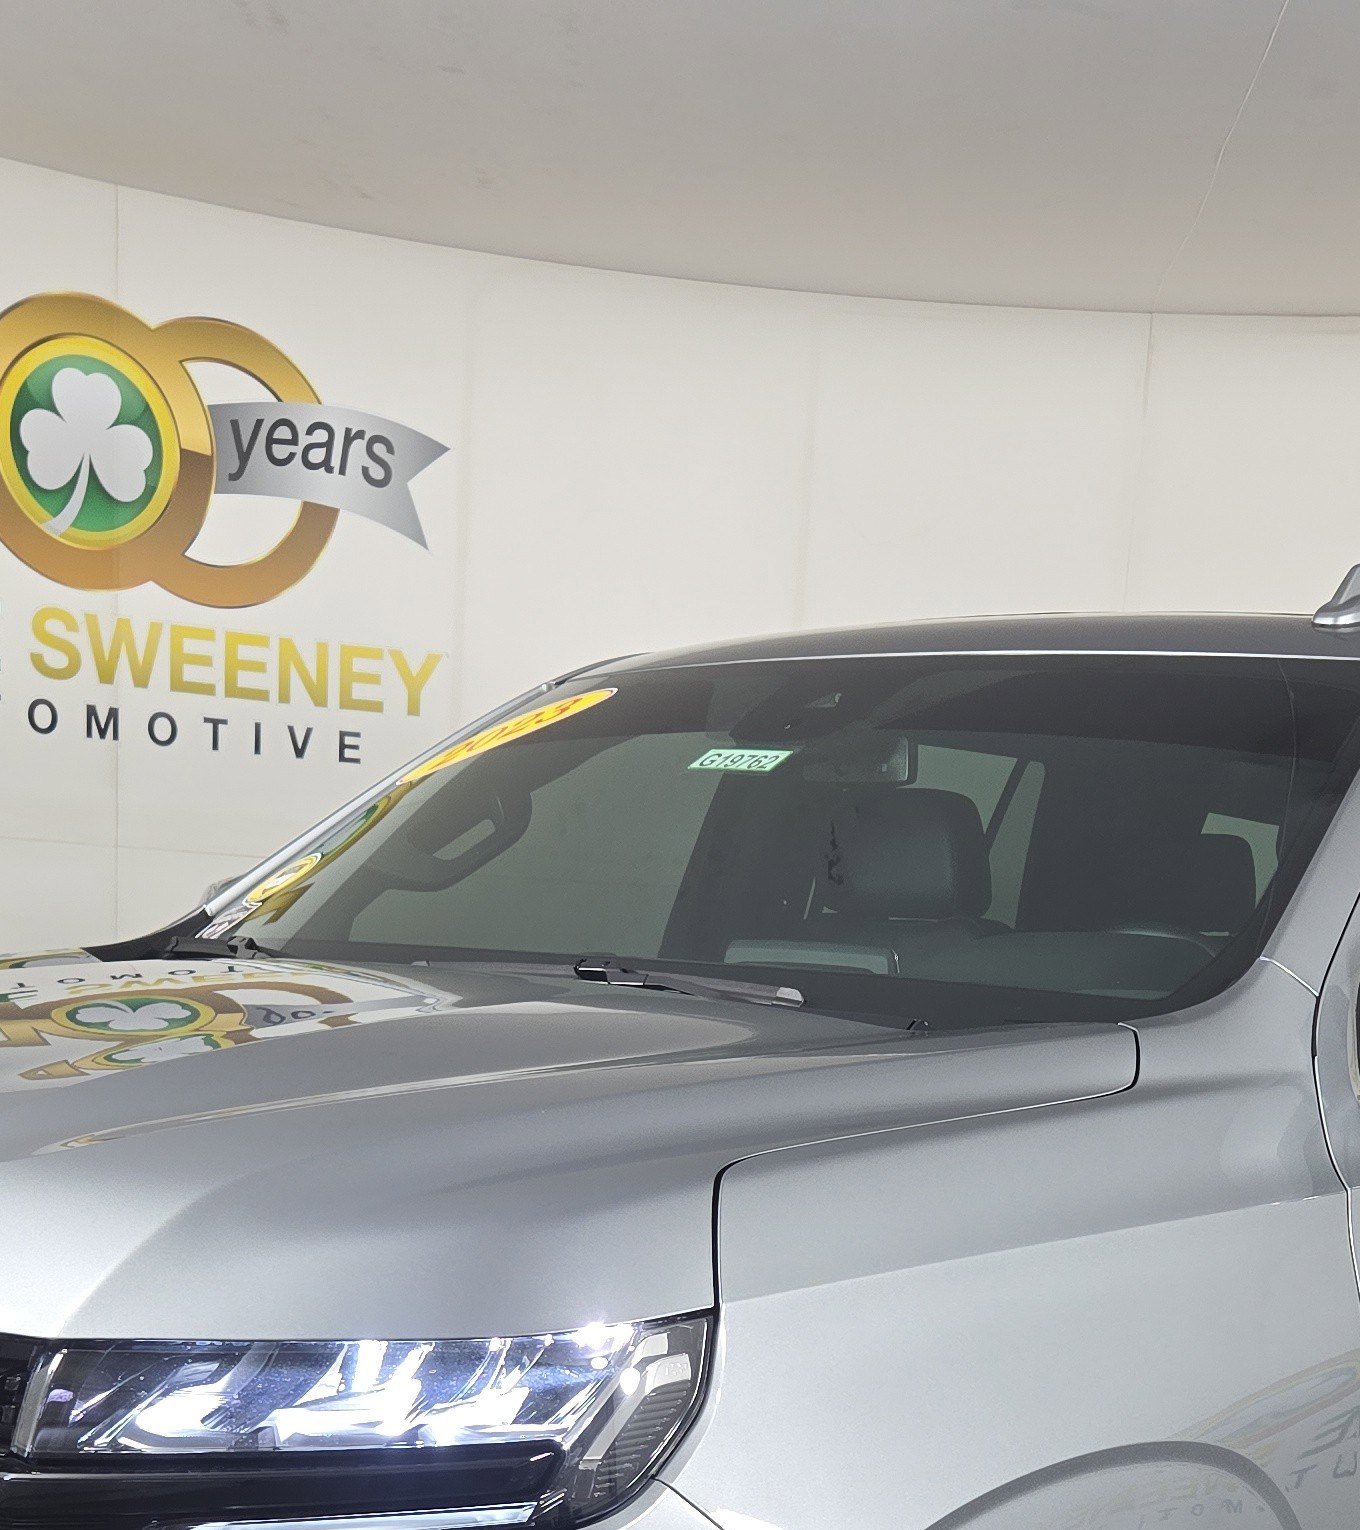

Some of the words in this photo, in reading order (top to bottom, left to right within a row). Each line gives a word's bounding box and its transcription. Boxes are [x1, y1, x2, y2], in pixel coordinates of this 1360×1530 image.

[227, 414, 395, 489] years
[30, 606, 444, 717] SWEENEY
[427, 697, 583, 771] 2023
[699, 753, 780, 770] G19762
